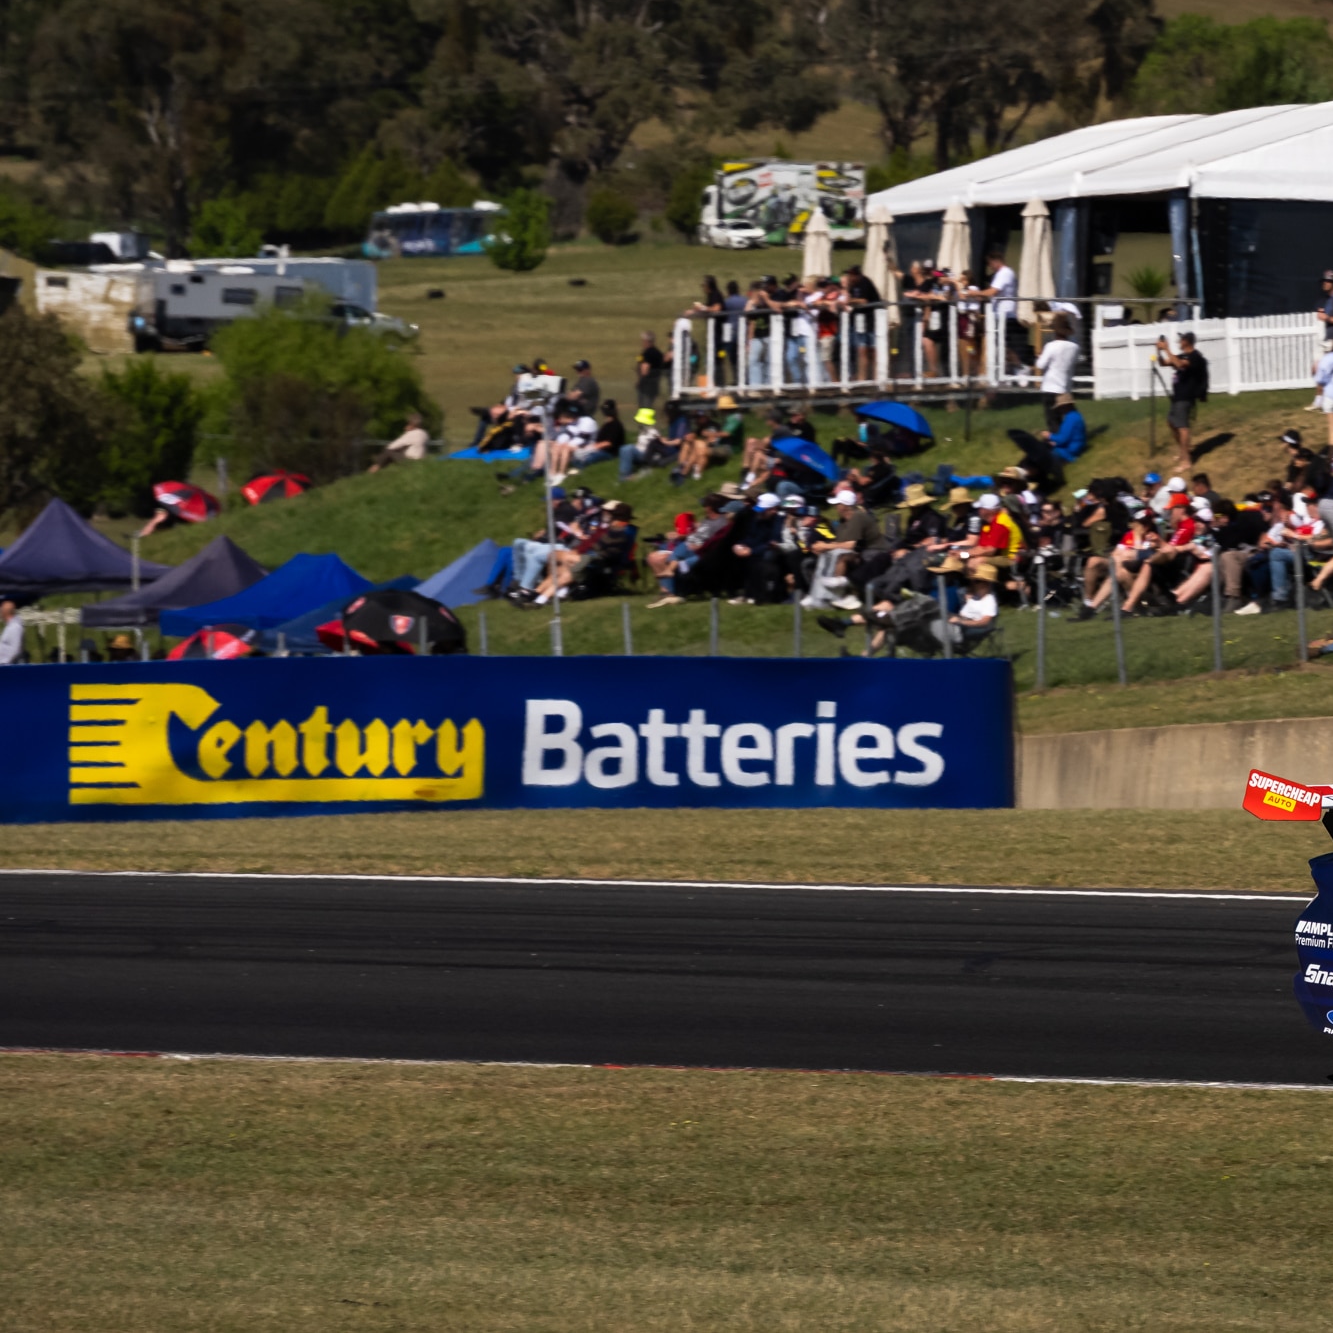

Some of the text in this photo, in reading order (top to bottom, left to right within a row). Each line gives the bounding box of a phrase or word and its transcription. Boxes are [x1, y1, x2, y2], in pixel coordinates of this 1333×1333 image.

[69, 682, 945, 805] Century Batteries
[1249, 772, 1320, 807] SUPERCHEAP
[1267, 795, 1292, 809] AUTO
[1295, 933, 1326, 949] Premium
